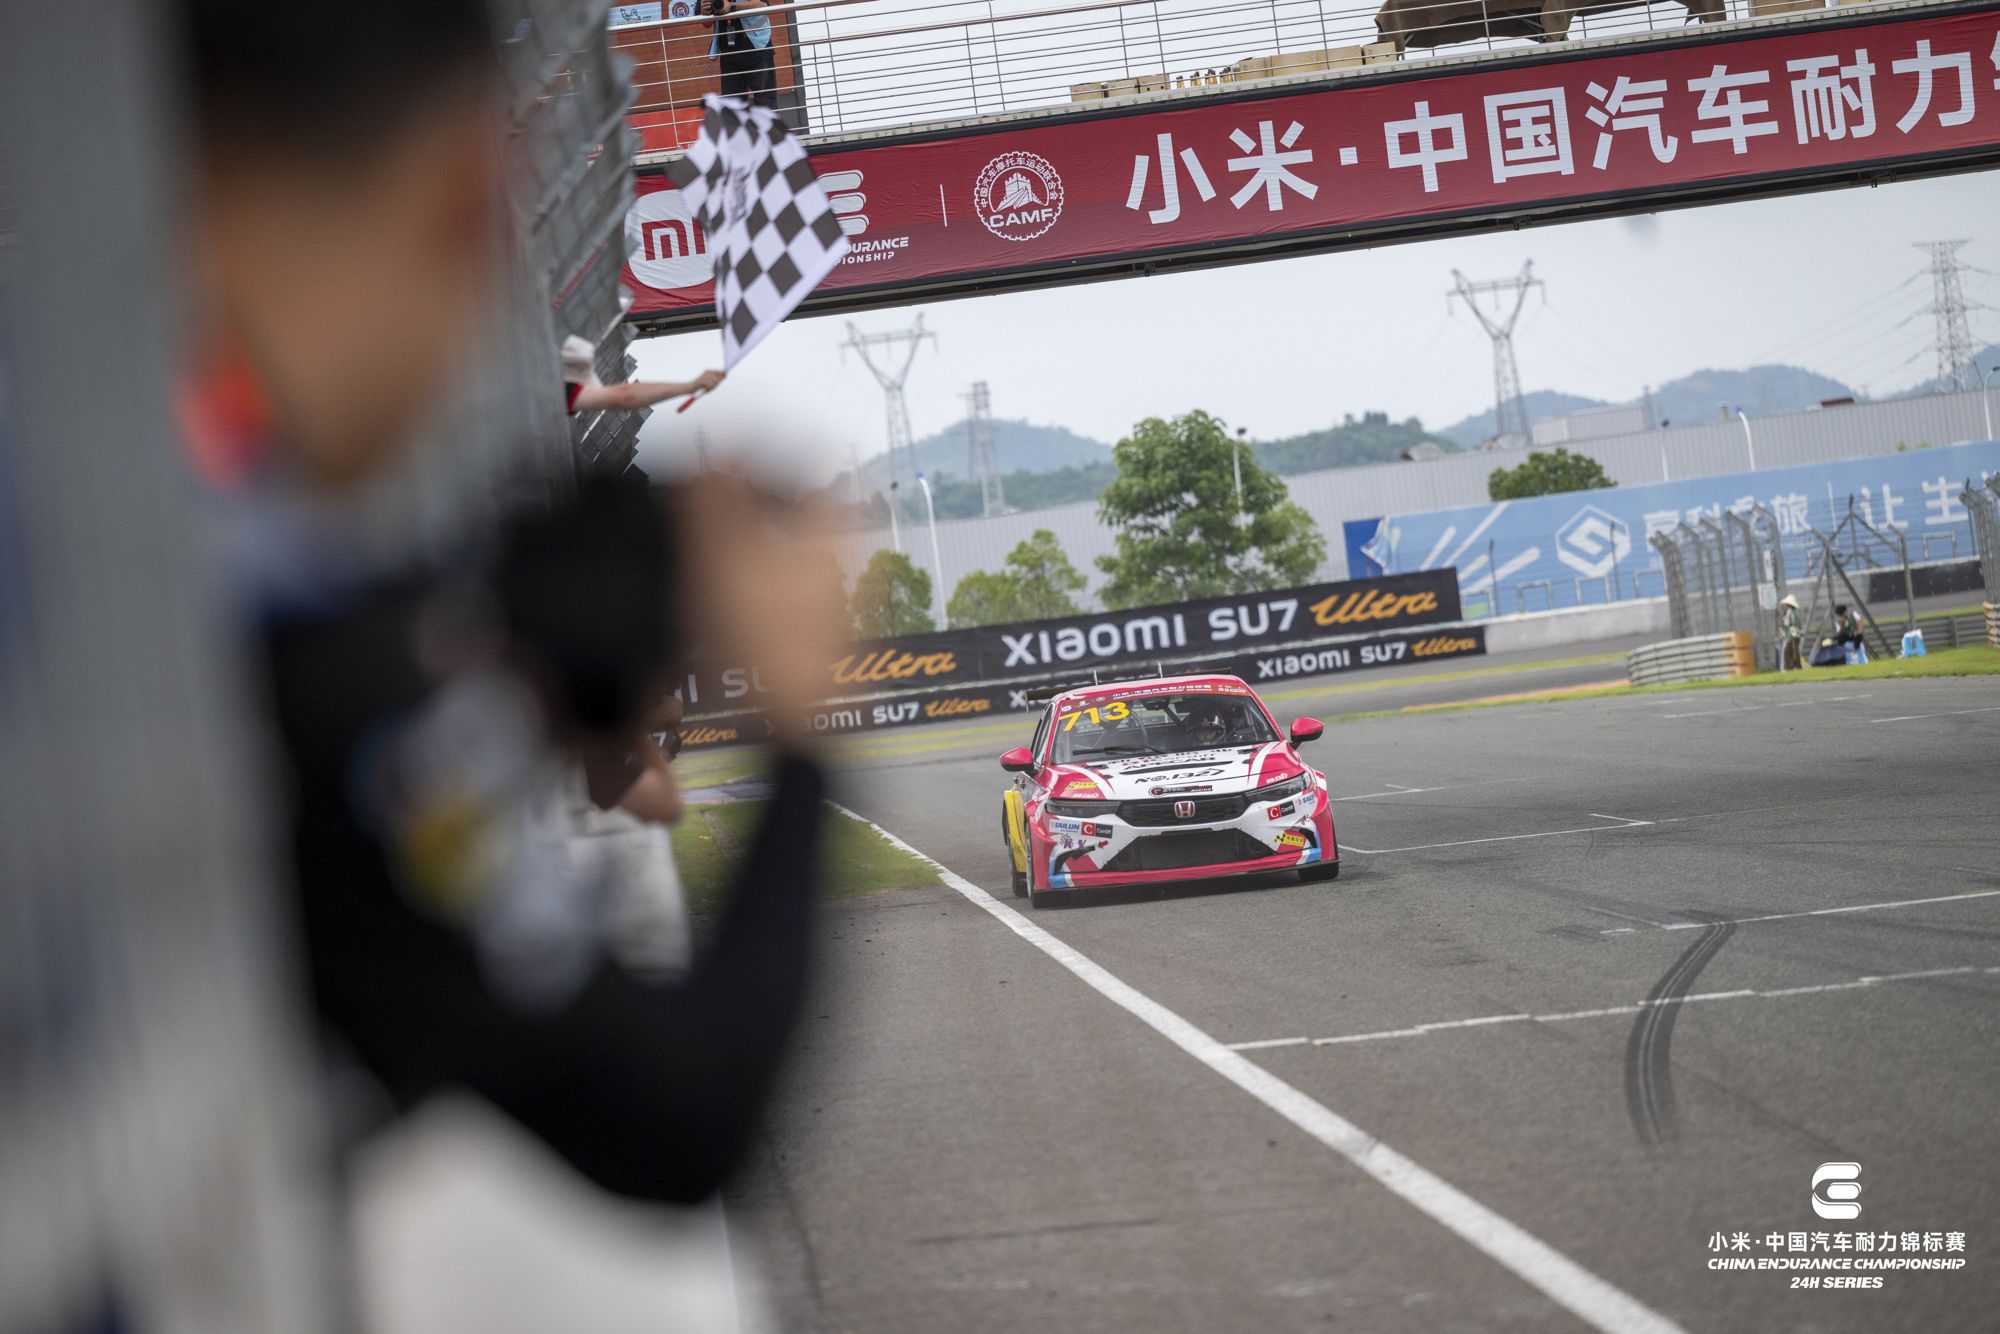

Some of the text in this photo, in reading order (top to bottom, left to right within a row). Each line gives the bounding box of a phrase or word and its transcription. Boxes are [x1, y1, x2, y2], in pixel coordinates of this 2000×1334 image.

[1126, 30, 2000, 225] 小米·中国汽车耐力
[989, 208, 1053, 228] CAMF
[1208, 599, 1298, 641] SU7
[1309, 589, 1438, 626] Ultra
[1361, 642, 1407, 664] SU7
[1411, 636, 1478, 657] Ultra
[872, 701, 920, 725] SU7
[924, 697, 990, 717] Ultra
[1059, 701, 1130, 732] 713
[1054, 822, 1080, 830] SAILUN
